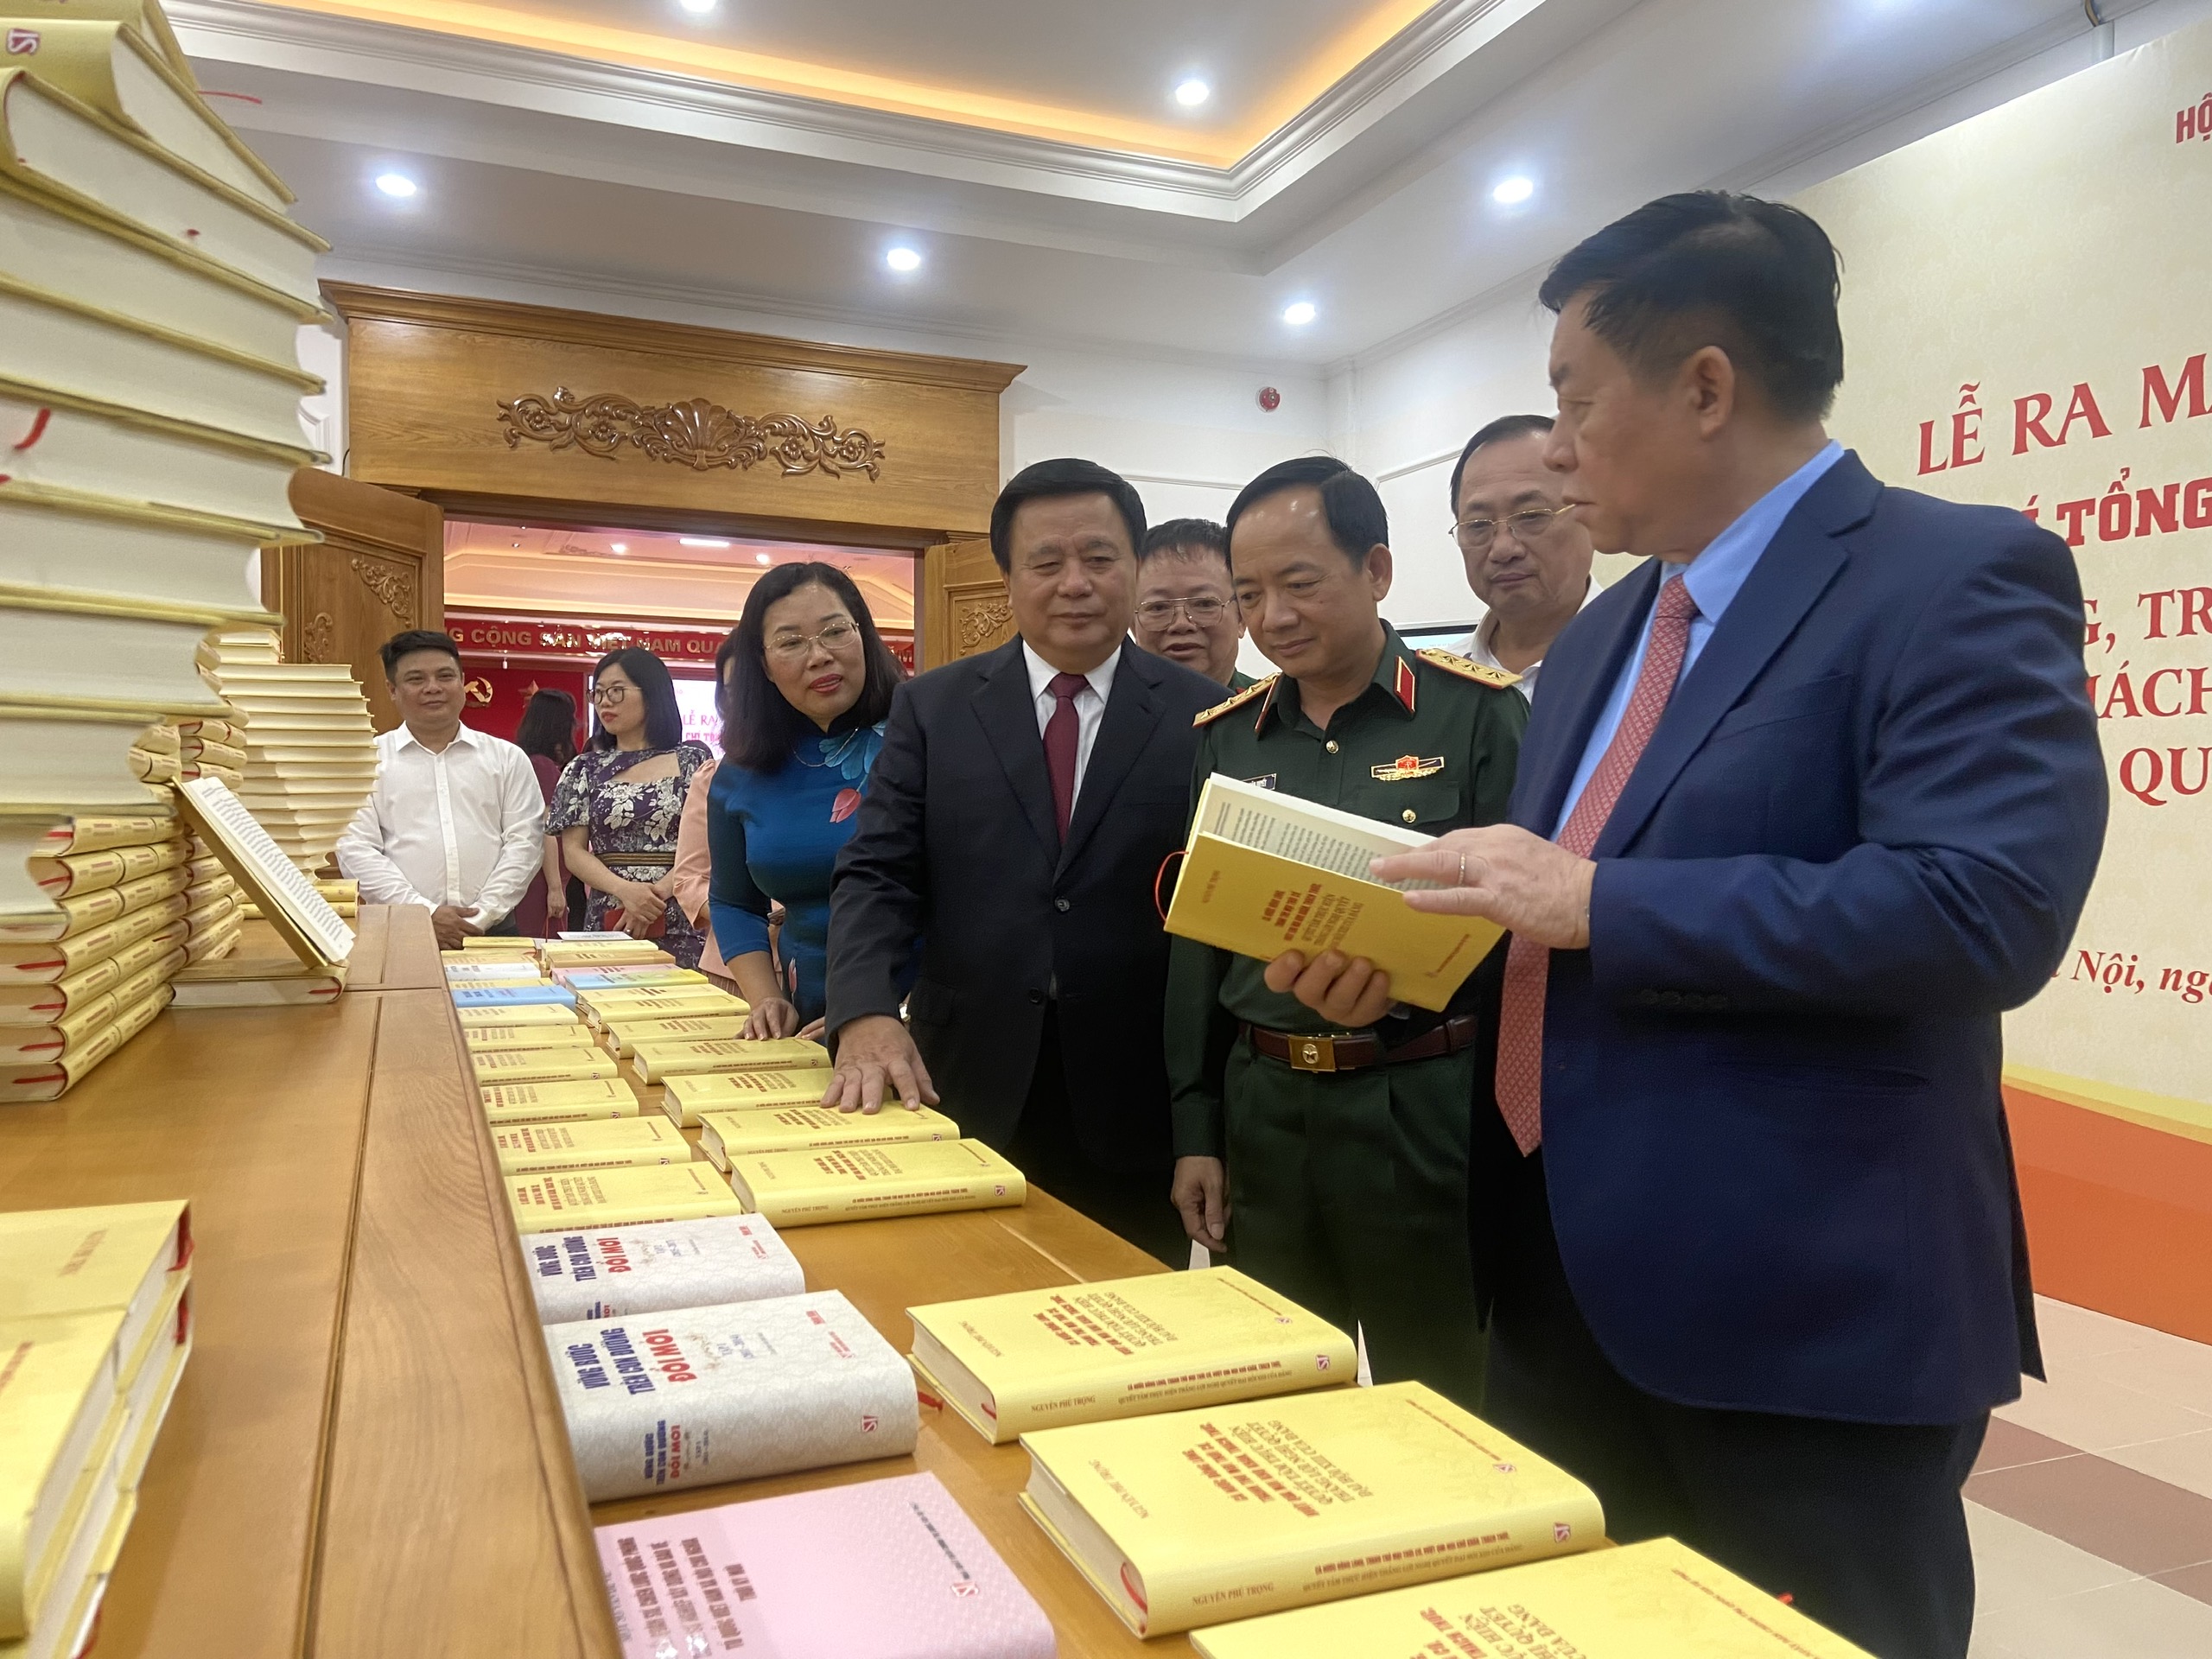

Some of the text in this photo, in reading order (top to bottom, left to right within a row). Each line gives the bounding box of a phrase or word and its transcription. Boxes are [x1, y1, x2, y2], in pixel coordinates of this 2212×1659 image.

[1916, 381, 1986, 476] LỄ
[2012, 382, 2112, 455] RA
[2056, 467, 2212, 547] TỔNG
[471, 625, 531, 647] CỘNG
[2120, 747, 2212, 806] QU
[2070, 950, 2145, 994] Nội,
[565, 1343, 601, 1367] BƯỚC
[577, 1366, 611, 1389] VỮNG
[601, 1327, 656, 1395] TRÊN CON ĐƯỜNG
[639, 1329, 697, 1382] ĐỔI MỚI
[1059, 1396, 1072, 1408] PHÚ
